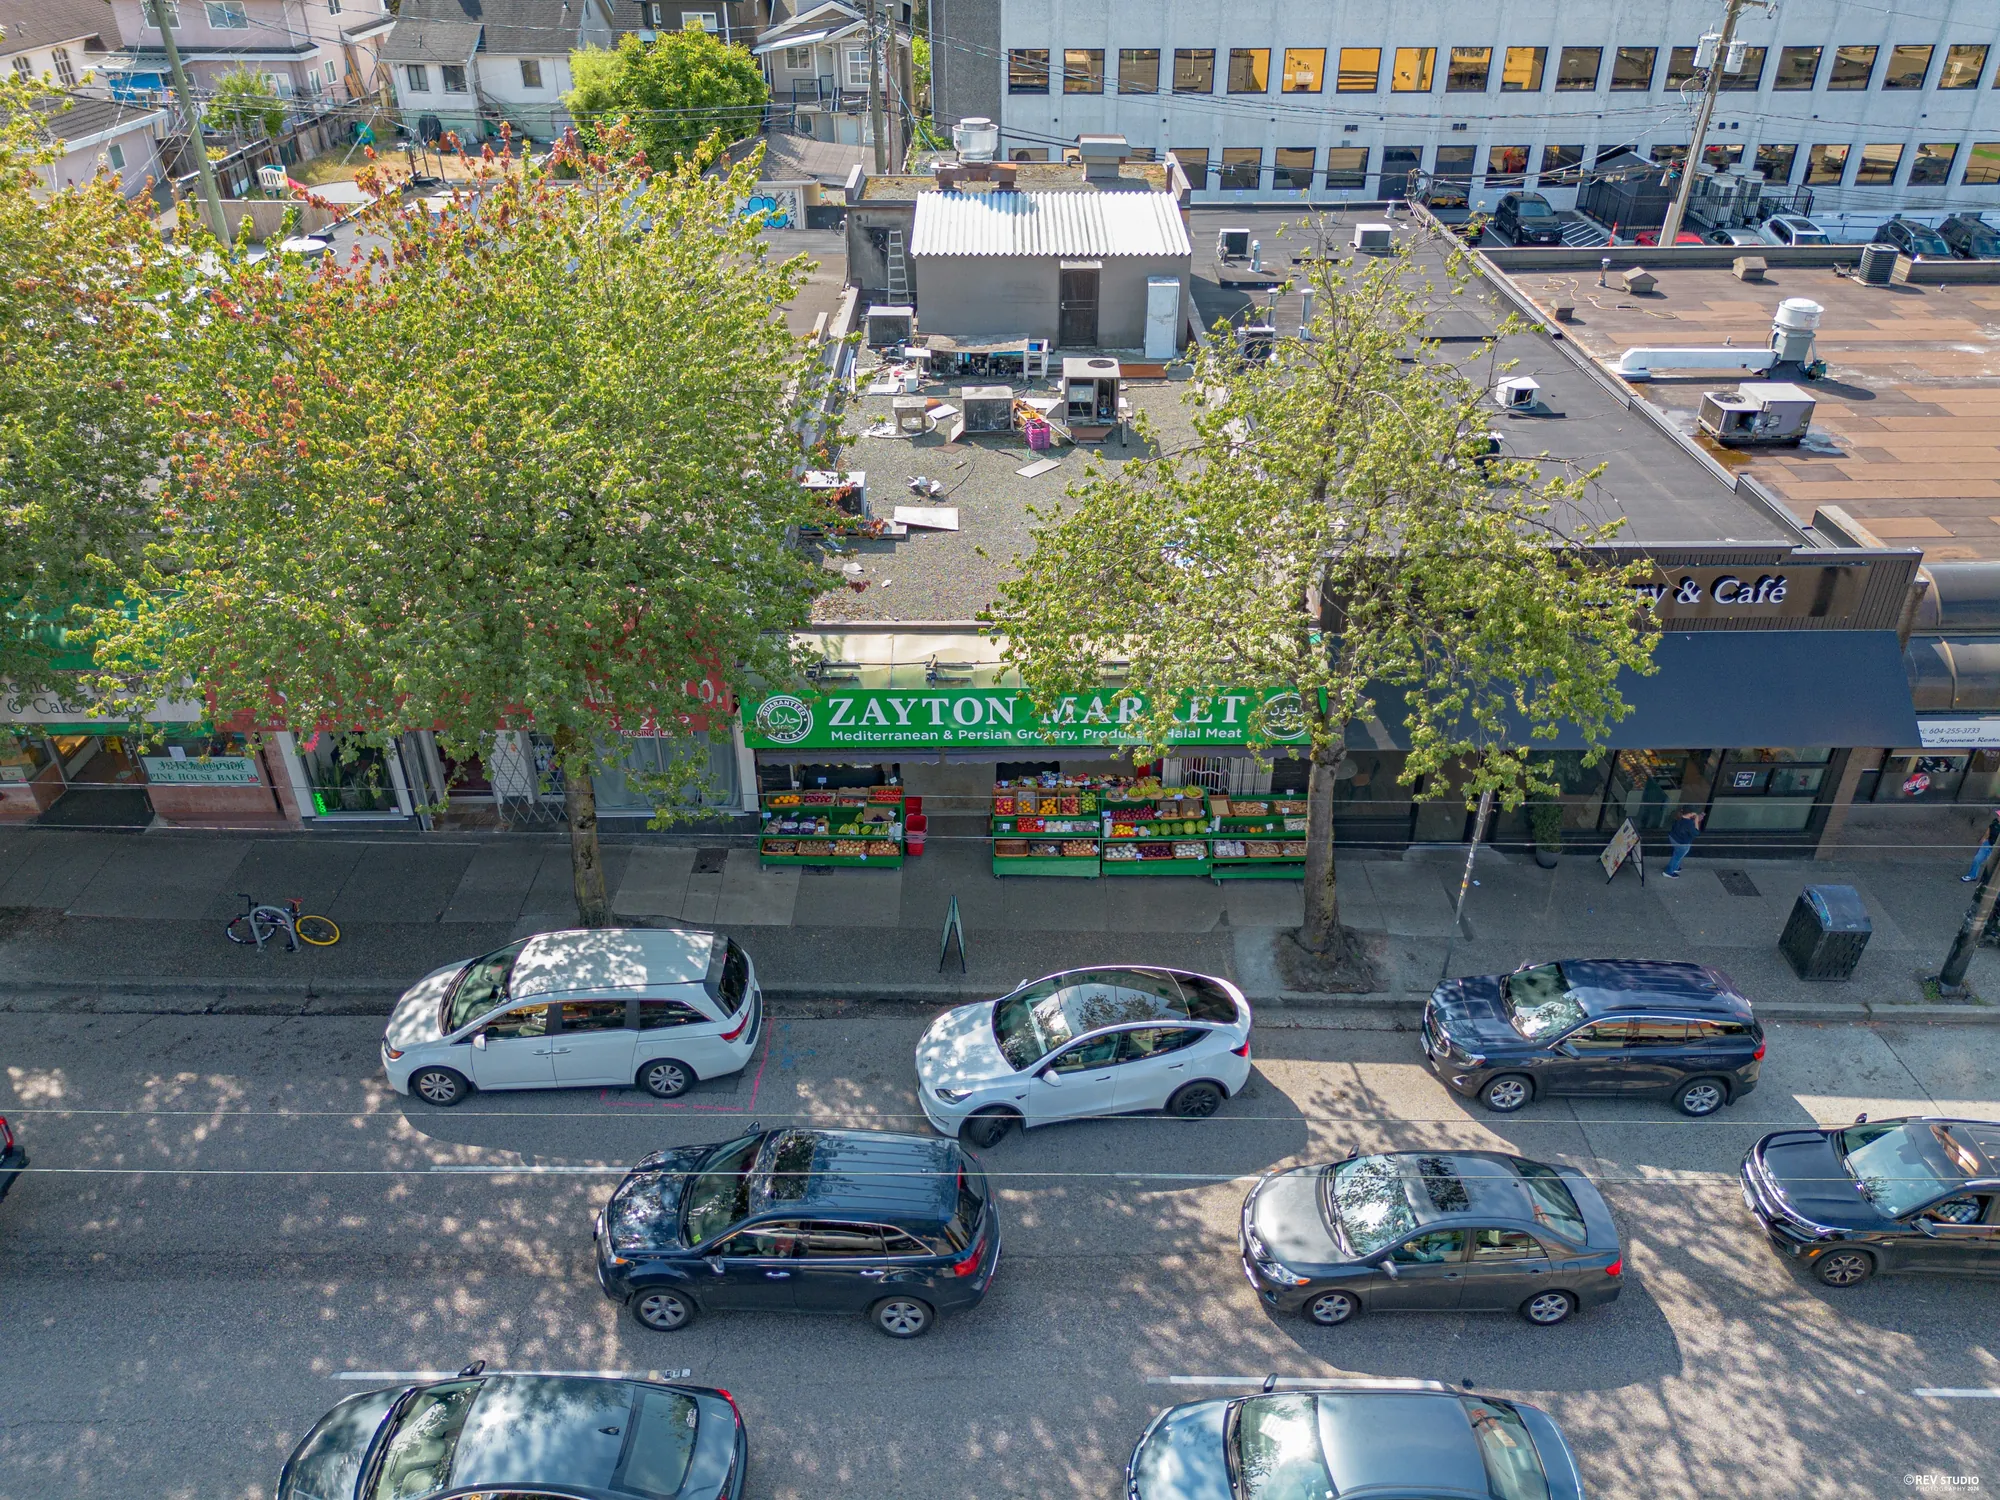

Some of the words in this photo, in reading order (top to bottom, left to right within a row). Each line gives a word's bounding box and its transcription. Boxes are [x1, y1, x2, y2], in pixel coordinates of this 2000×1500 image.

[1676, 580, 1702, 604] &
[1714, 579, 1788, 604] Café
[7, 698, 23, 714] &
[32, 697, 82, 714] Cake
[762, 700, 806, 716] GUARANTEED
[828, 697, 1018, 726] ZAYTON
[831, 729, 938, 741] Mediterranean
[943, 730, 953, 740] &
[958, 729, 1012, 740] Persian
[1206, 728, 1242, 738] Meat
[1928, 727, 1981, 735] 604-255-3733
[150, 773, 175, 781] PINE
[177, 773, 214, 781] HOUSE
